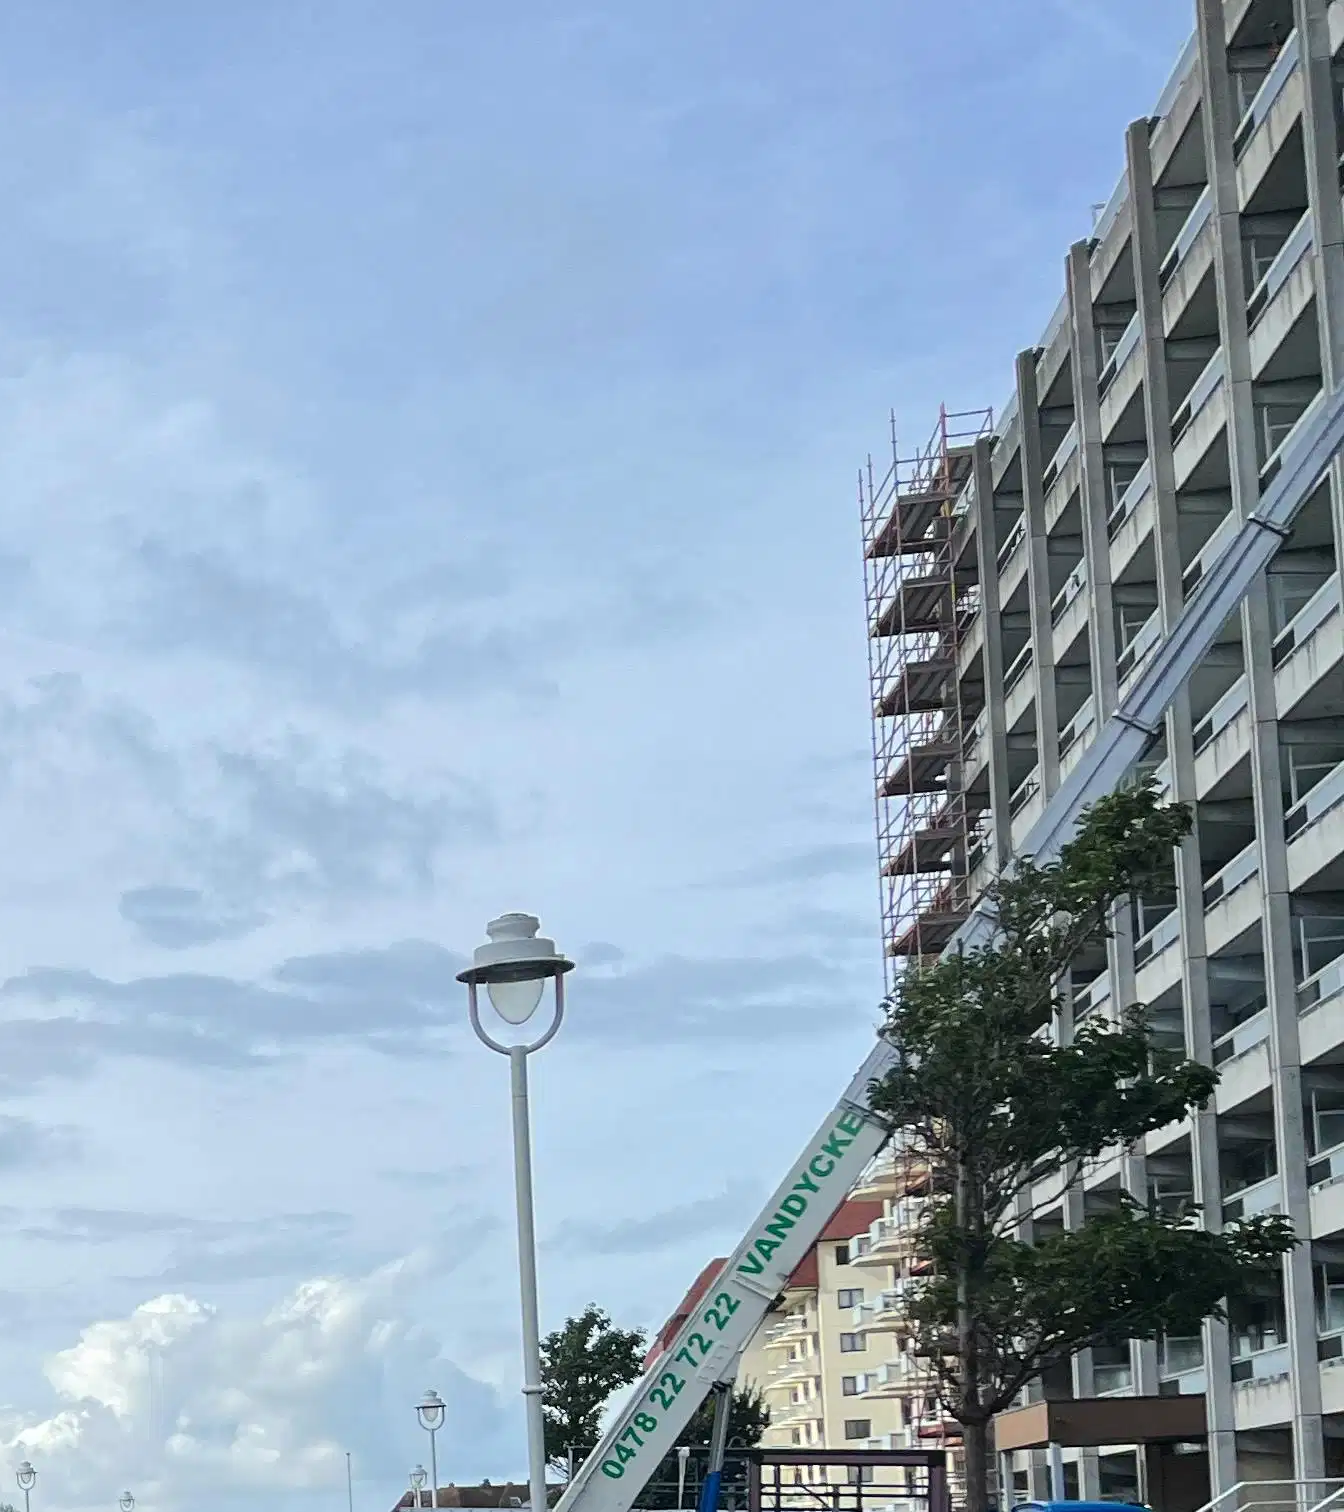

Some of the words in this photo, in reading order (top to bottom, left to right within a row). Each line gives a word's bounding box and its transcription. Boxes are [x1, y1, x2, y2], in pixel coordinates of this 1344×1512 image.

[601, 1412, 658, 1479] 0478
[649, 1372, 687, 1411] 22
[674, 1332, 713, 1368] 72
[703, 1292, 741, 1332] 22
[736, 1111, 865, 1276] VANDYCKE
